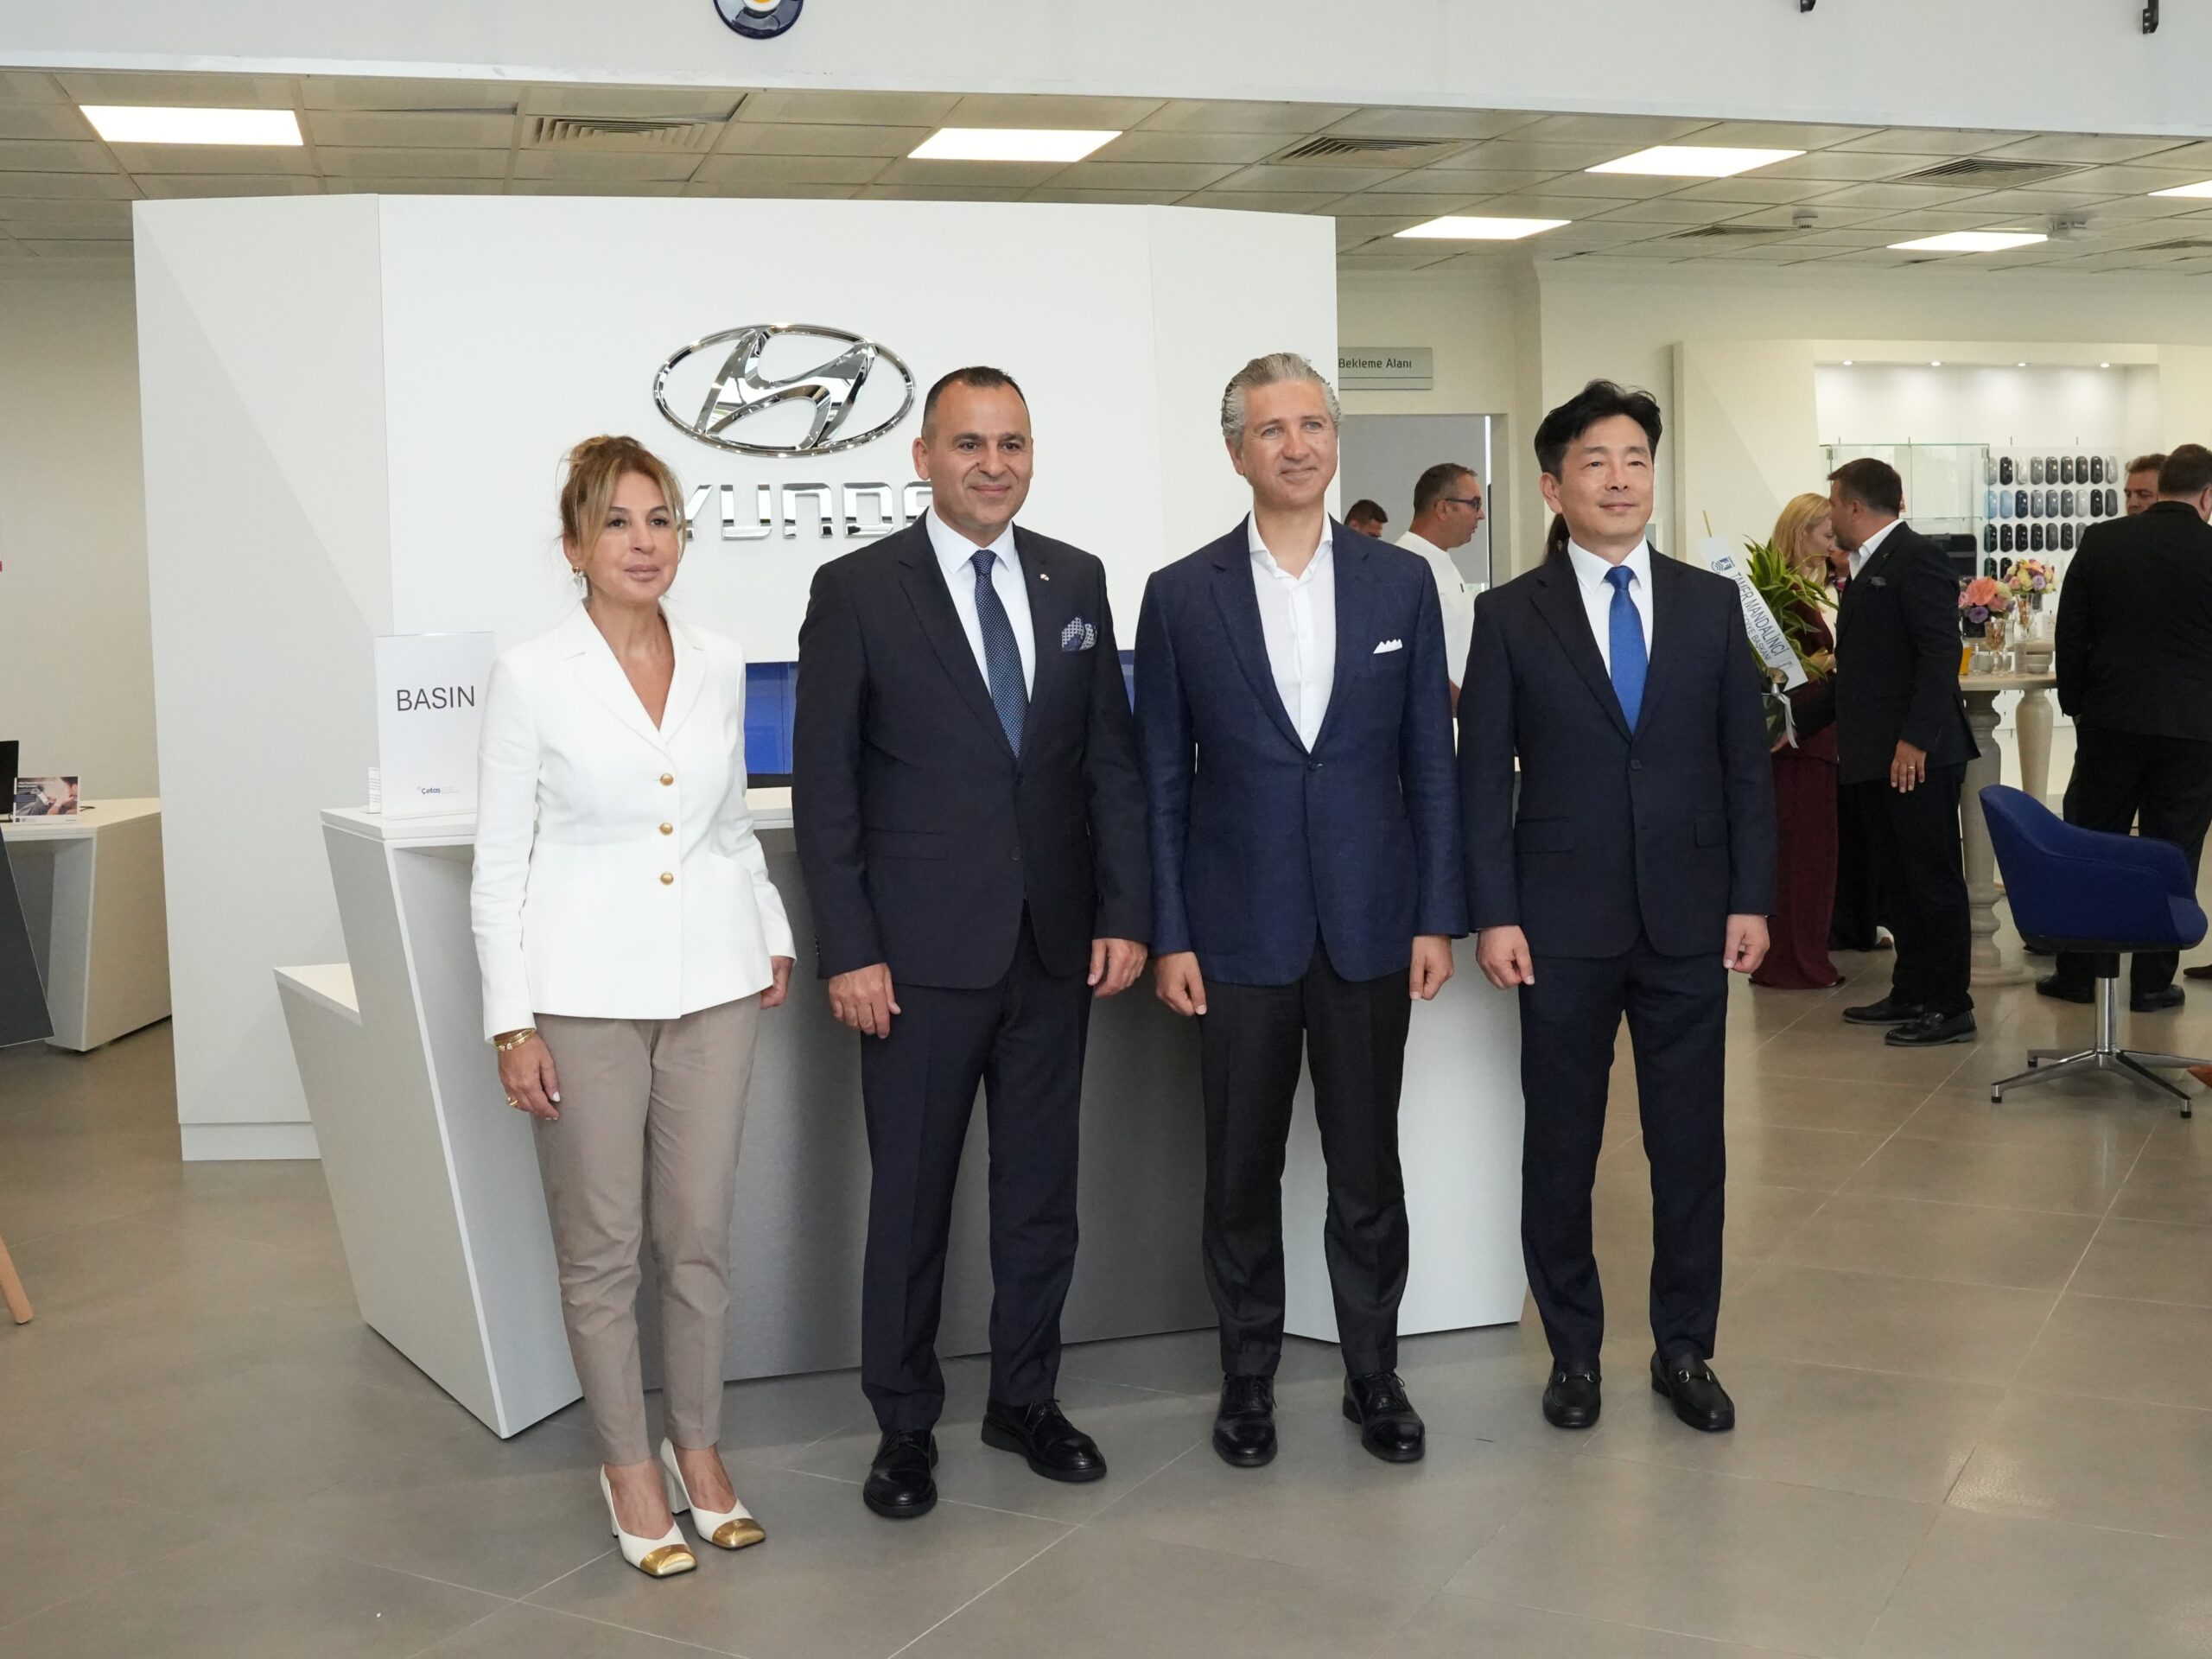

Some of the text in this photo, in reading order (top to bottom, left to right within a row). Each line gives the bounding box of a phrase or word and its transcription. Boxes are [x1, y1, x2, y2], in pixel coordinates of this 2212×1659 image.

[1338, 358, 1412, 368] Bekleme Alanı
[397, 685, 475, 711] BASIN
